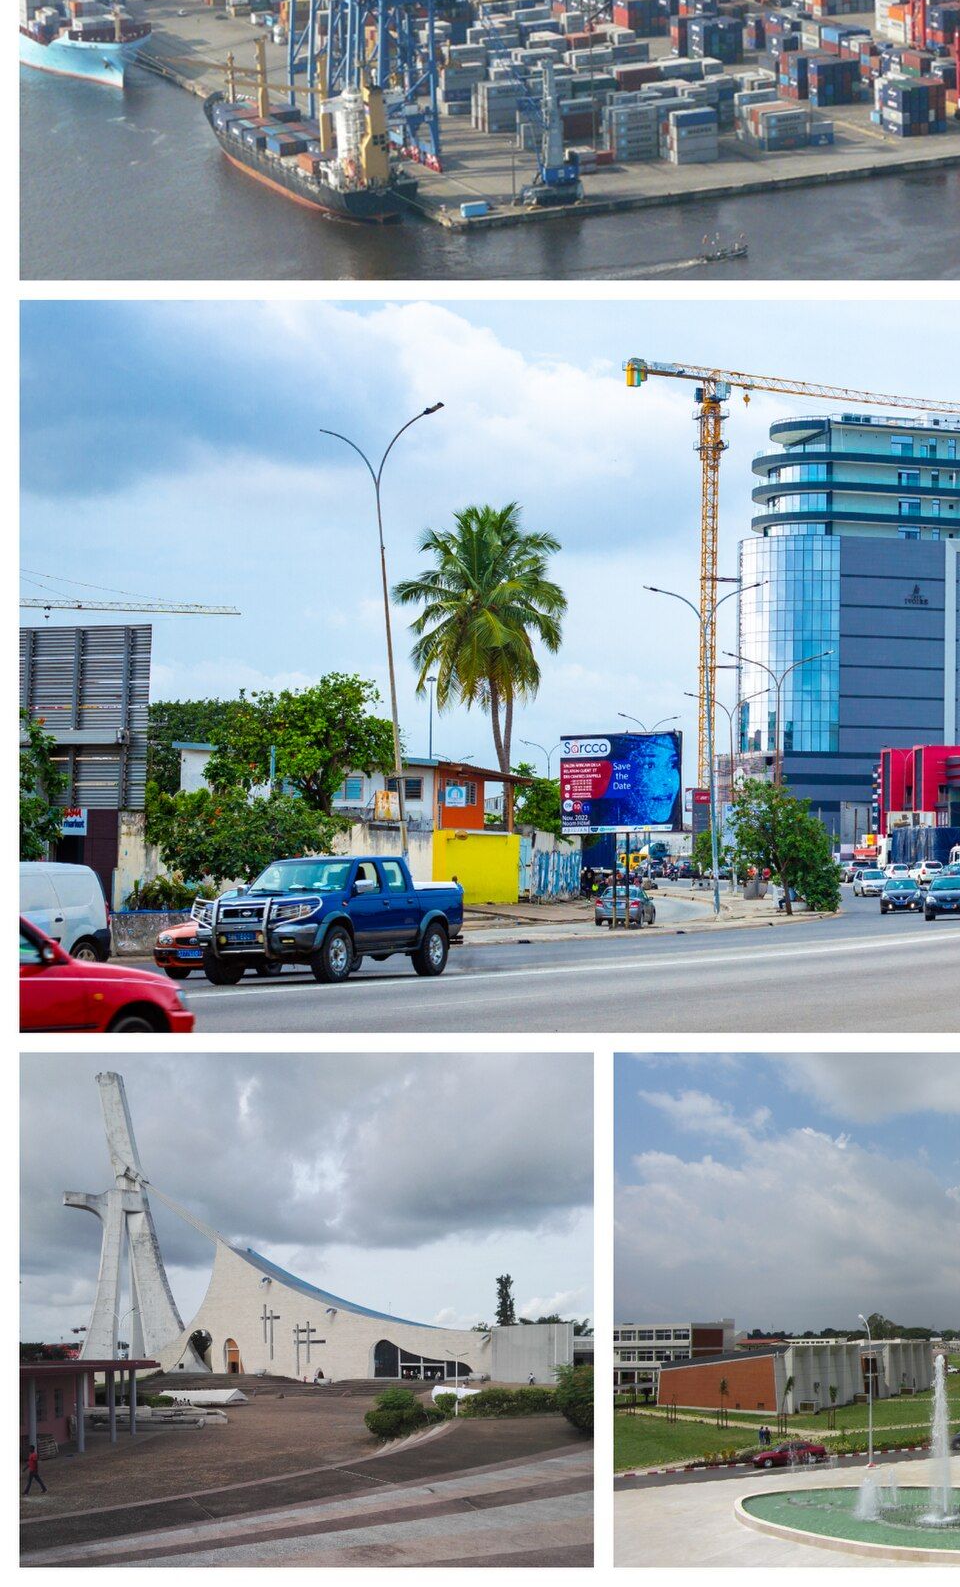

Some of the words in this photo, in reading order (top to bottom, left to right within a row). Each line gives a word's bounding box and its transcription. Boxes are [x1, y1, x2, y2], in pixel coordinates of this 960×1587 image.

[563, 740, 608, 754] Sarcca
[613, 763, 631, 771] Save
[615, 772, 629, 780] the
[613, 782, 631, 790] Date
